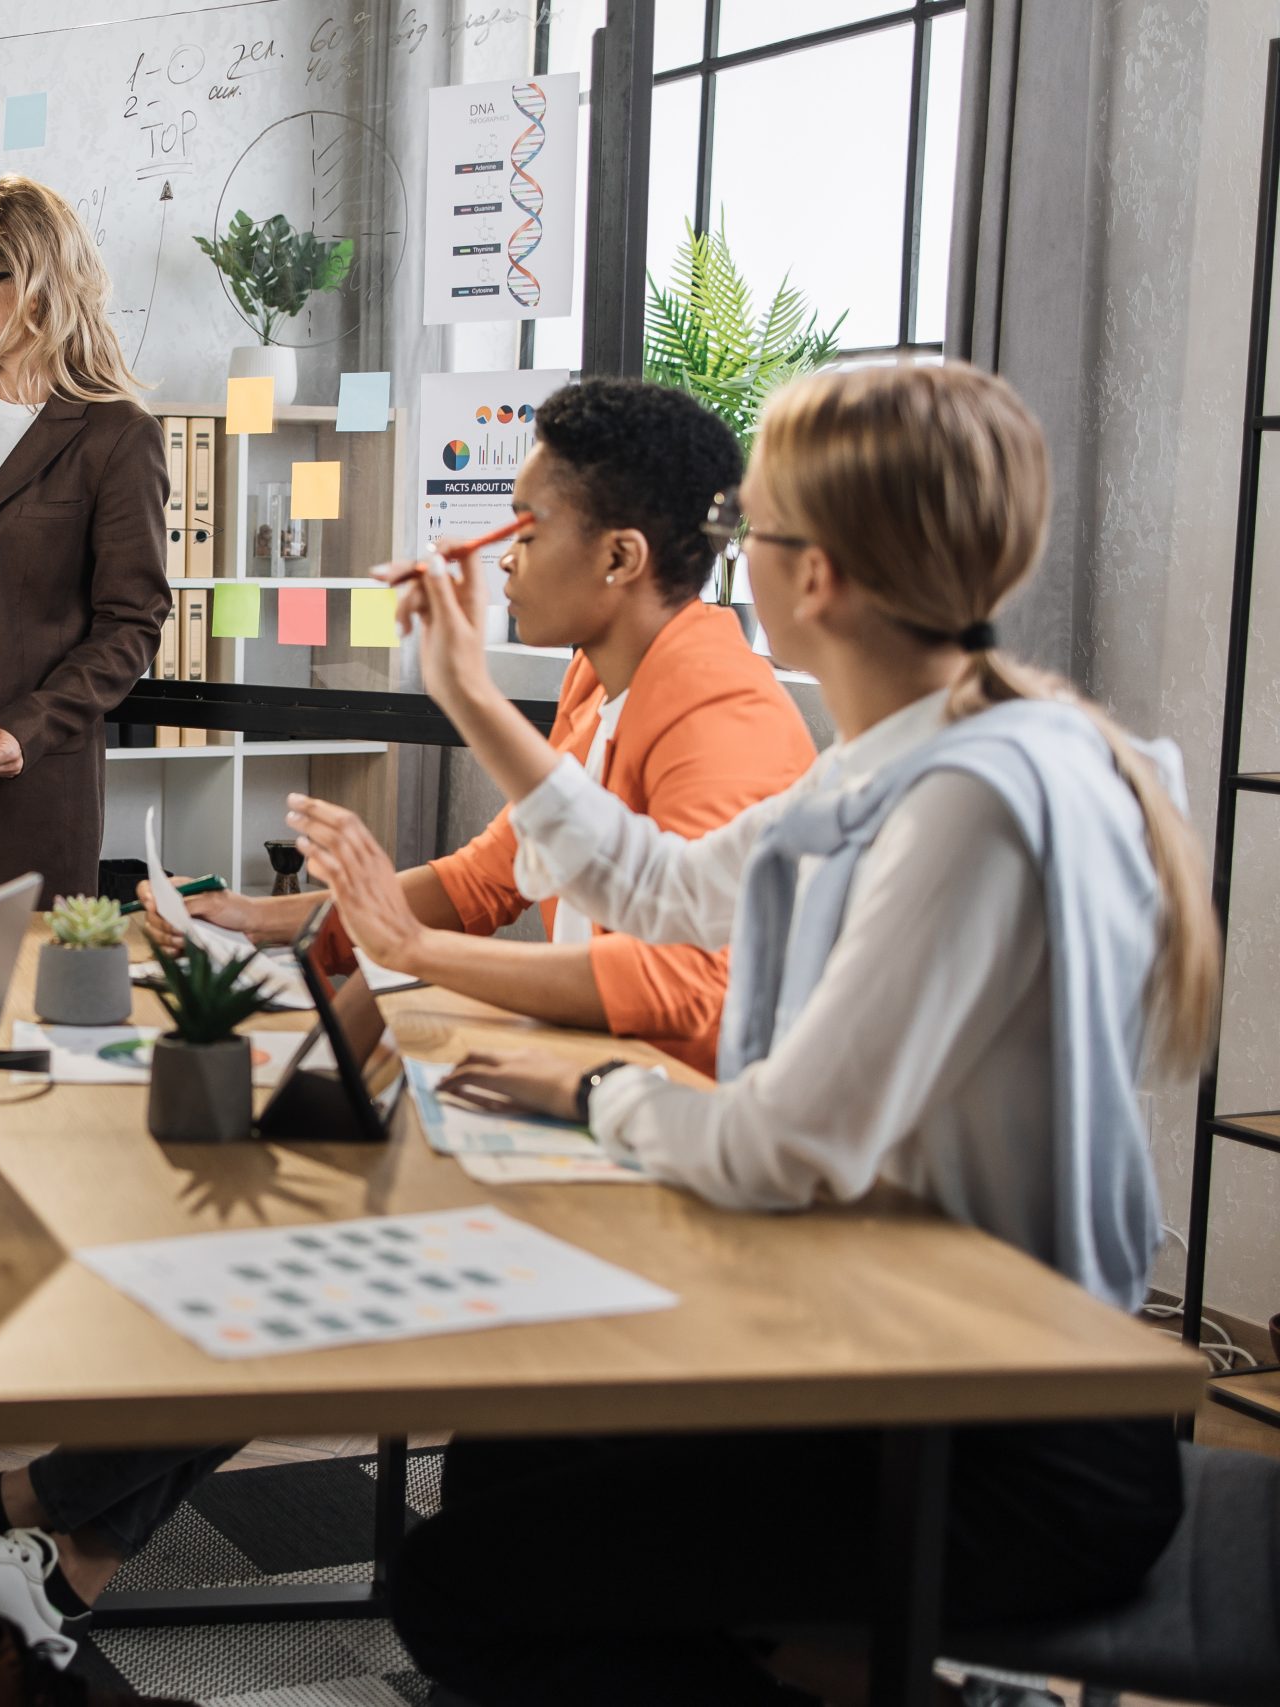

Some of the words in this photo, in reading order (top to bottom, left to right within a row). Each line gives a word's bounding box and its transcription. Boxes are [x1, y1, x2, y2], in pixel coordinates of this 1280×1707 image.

[469, 102, 495, 116] DNA
[140, 109, 198, 159] TOP
[474, 163, 497, 172] Adenine
[473, 204, 496, 213] Guanine
[472, 246, 495, 255] Thymine
[471, 286, 494, 296] Cytosine
[445, 483, 470, 492] FACTS
[471, 483, 500, 492] ABOUT
[500, 482, 514, 492] DN
